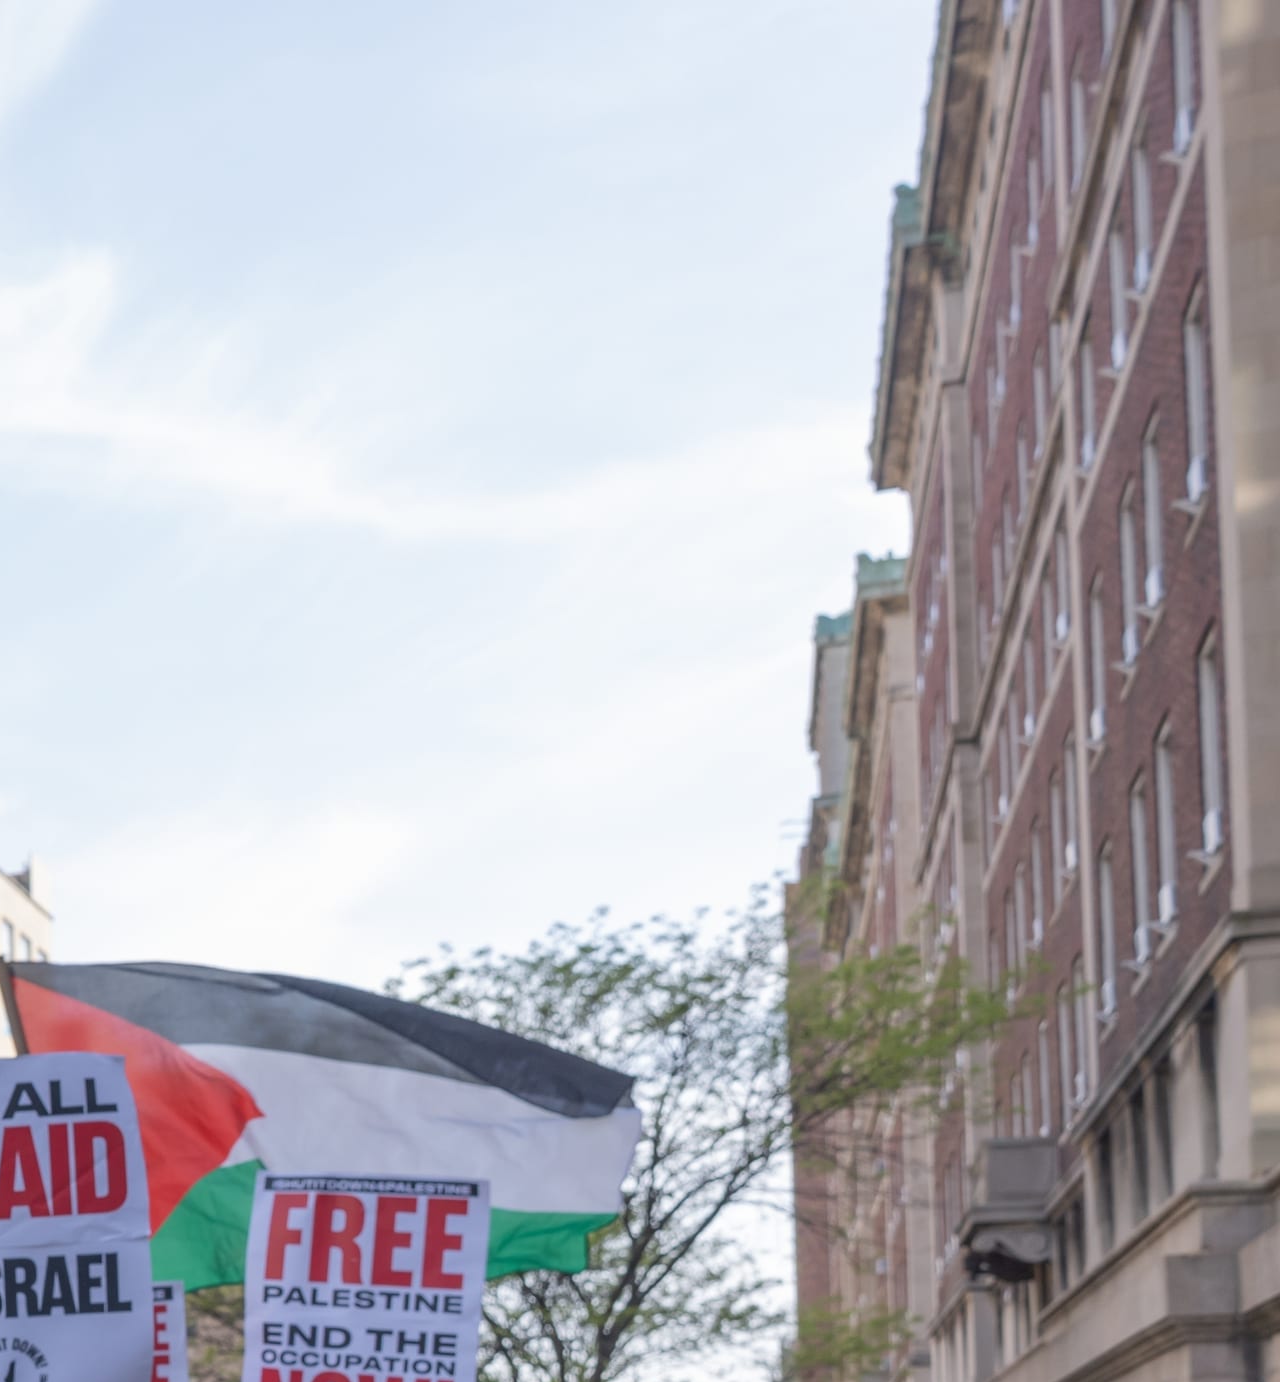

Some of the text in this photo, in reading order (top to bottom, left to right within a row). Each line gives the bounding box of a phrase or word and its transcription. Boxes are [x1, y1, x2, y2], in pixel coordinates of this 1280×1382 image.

[2, 1077, 119, 1120] ALL
[263, 1192, 469, 1290] FREE
[262, 1285, 464, 1315] PALESTINE
[11, 1337, 49, 1369] DOWN!
[262, 1322, 459, 1358] END THE
[261, 1349, 457, 1377] OCCUPATION
